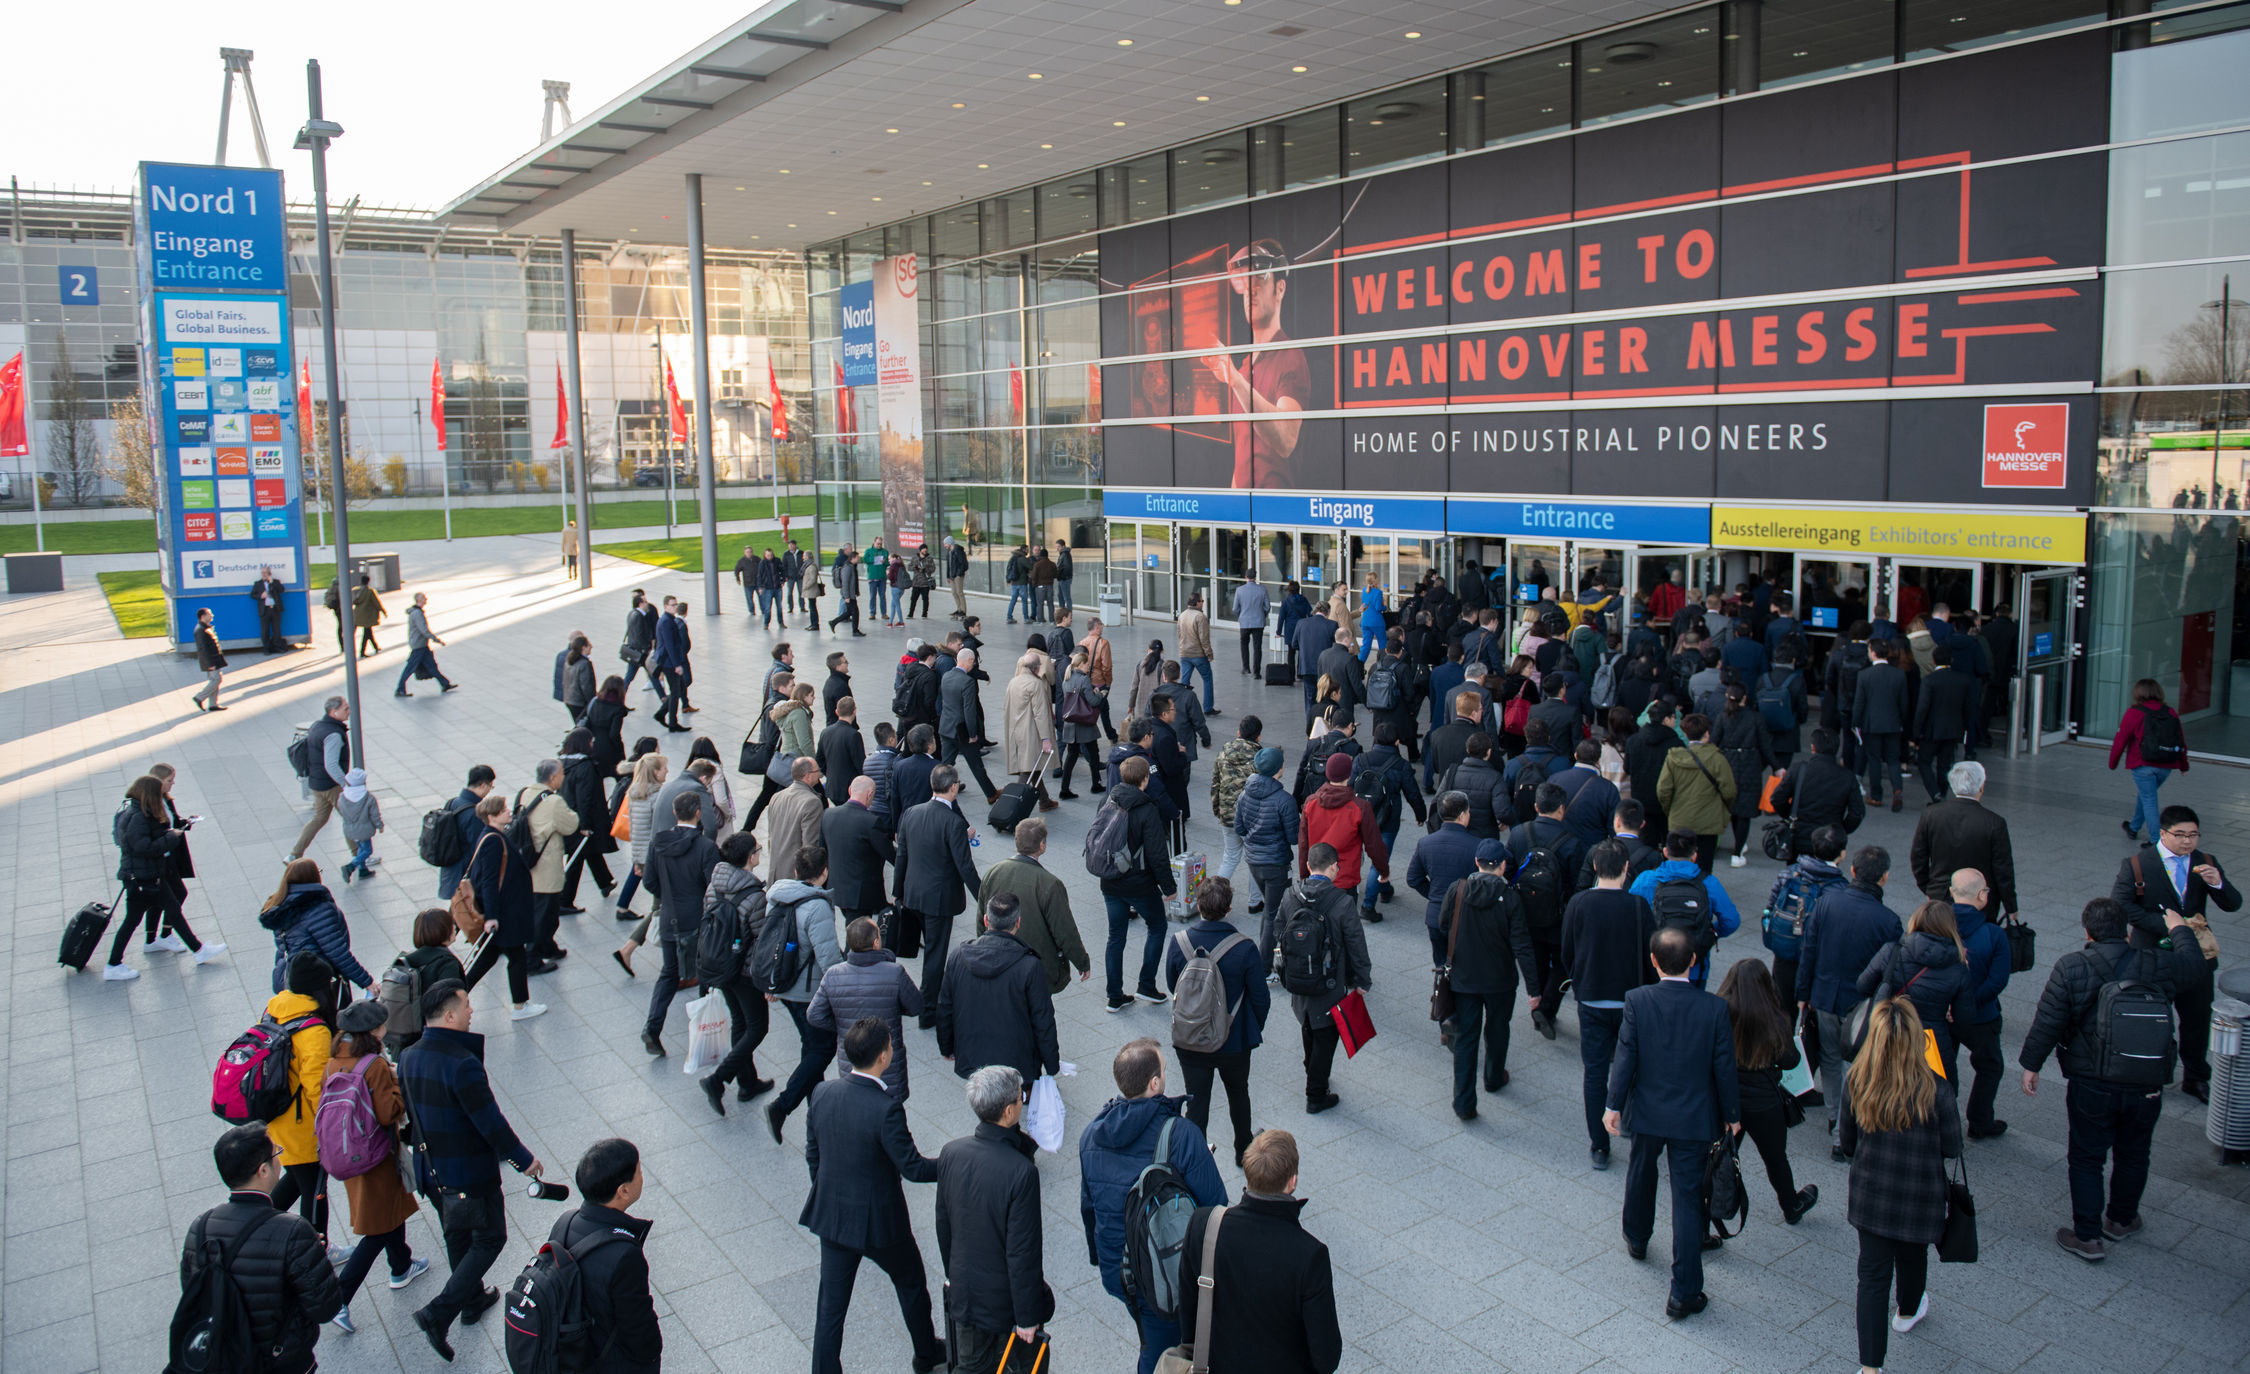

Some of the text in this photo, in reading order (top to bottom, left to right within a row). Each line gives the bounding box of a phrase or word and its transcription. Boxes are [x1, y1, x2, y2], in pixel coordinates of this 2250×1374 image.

[152, 184, 257, 216] Nord 1
[154, 231, 254, 259] Eingang
[157, 259, 263, 281] Entrance
[1352, 228, 1715, 315] WELCOME TO
[71, 273, 88, 297] 2
[175, 309, 247, 321] Global Fairs.
[843, 300, 873, 330] Nord
[176, 323, 270, 335] Global Business.
[844, 341, 874, 359] Eingang
[879, 339, 890, 352] Go
[1352, 303, 1930, 389] HANNOVER MESSE
[845, 361, 876, 378] Entrance
[880, 354, 908, 369] further
[253, 385, 273, 396] abf
[1353, 422, 1830, 453] HOME OF INDUSTRIAL PIONEERS
[255, 458, 281, 466] EMO
[1987, 452, 2062, 462] HANNOVER
[1999, 462, 2048, 471] MESSE
[1145, 494, 1199, 514] Entrance
[1309, 497, 1374, 526] Eingang
[187, 518, 211, 528] CITCF
[1522, 504, 1615, 532] Entrance
[1719, 520, 2053, 551] Ausstellereingang Exhibitors' entrance
[218, 562, 286, 573] Deutsche Messe
